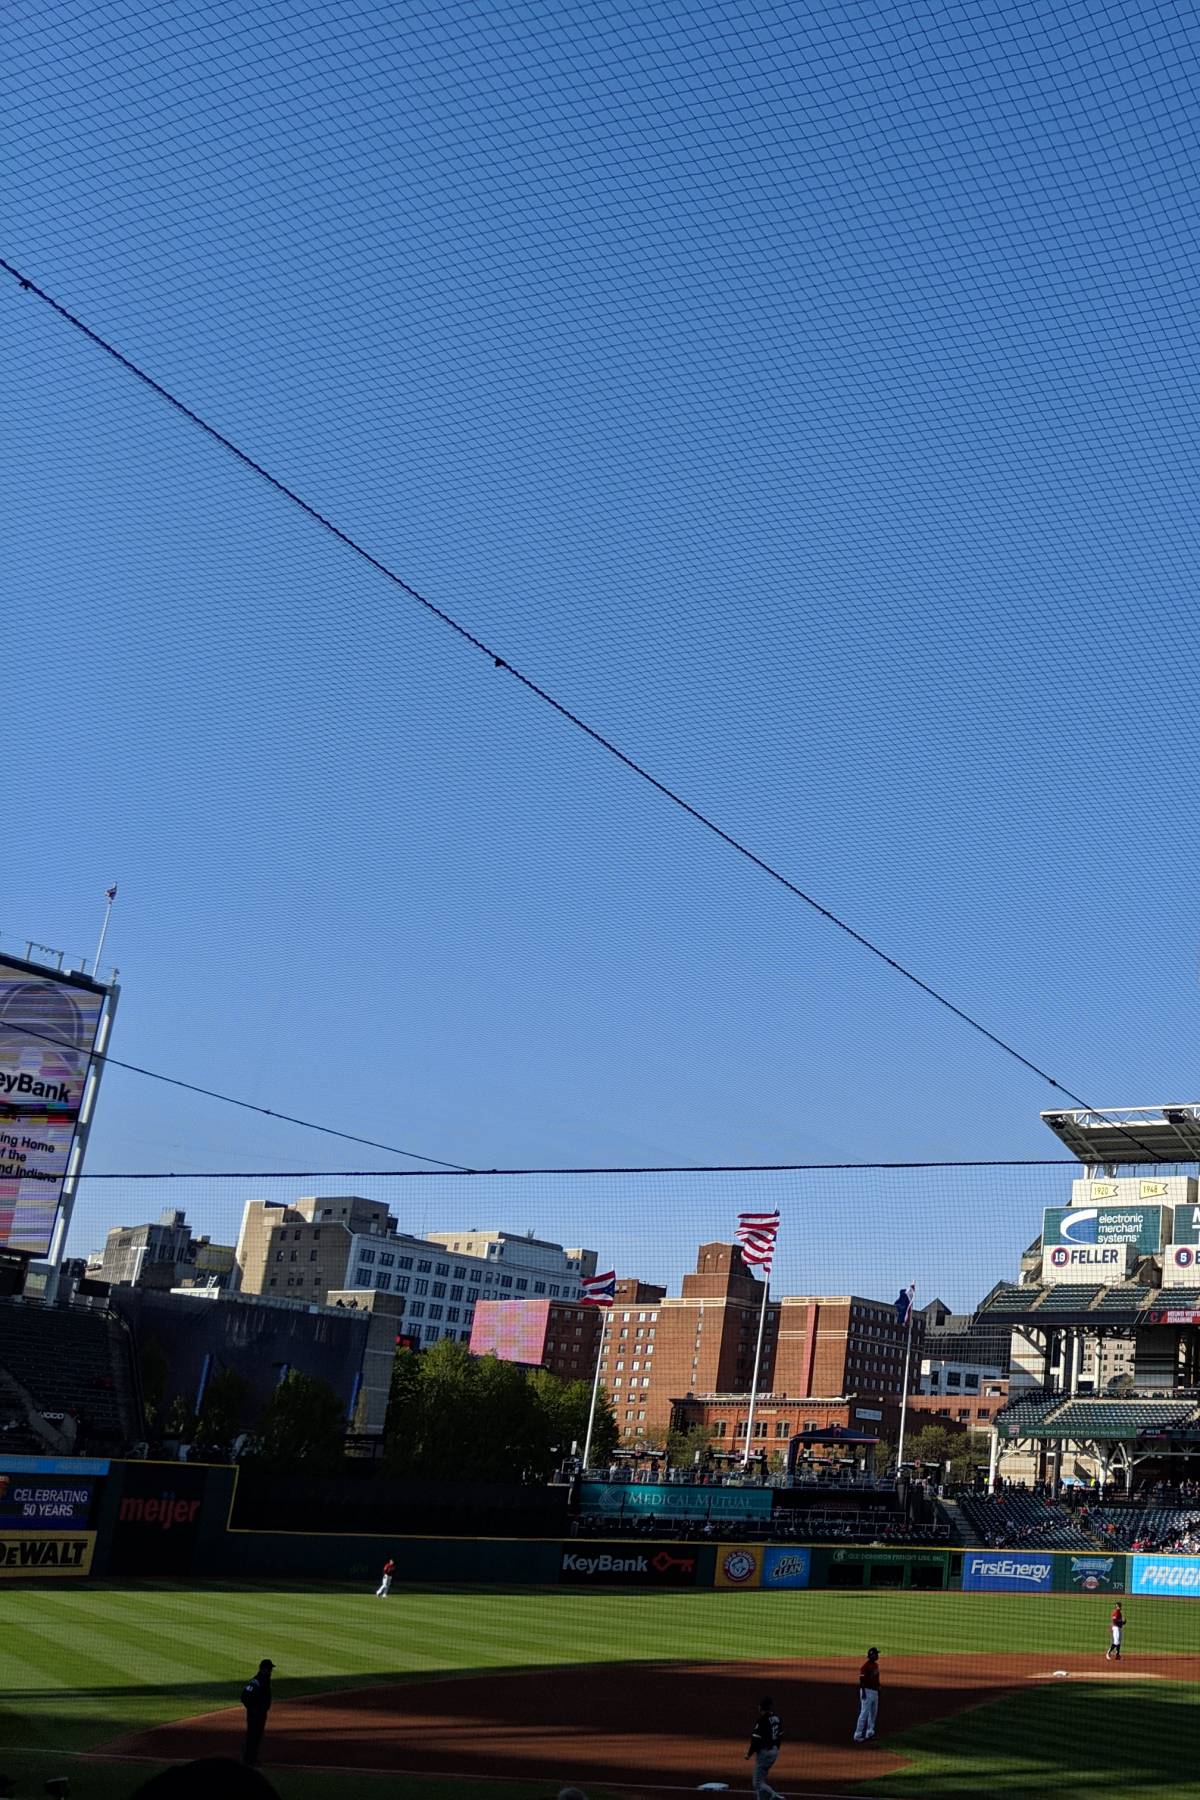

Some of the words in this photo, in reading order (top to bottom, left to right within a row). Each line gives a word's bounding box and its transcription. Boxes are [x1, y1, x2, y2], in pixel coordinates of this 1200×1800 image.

[21, 1136, 55, 1153] Home
[9, 1150, 26, 1162] the
[16, 1165, 56, 1183] Indians
[1094, 1186, 1109, 1195] 1920
[1098, 1213, 1143, 1224] electronic
[1098, 1223, 1142, 1233] merchant
[1097, 1234, 1138, 1244] systems
[1071, 1249, 1118, 1264] FELLER
[1180, 1252, 1187, 1262] 5
[14, 1488, 88, 1502] CELEBRATING
[629, 1492, 690, 1506] MEDICAL
[696, 1494, 752, 1510] MUTUAL
[23, 1504, 36, 1516] 50
[38, 1504, 73, 1517] YEARS
[119, 1492, 200, 1530] meijer
[562, 1554, 648, 1575] KeyBank
[971, 1559, 1050, 1580] FirstEnergy
[1112, 1582, 1124, 1591] 375
